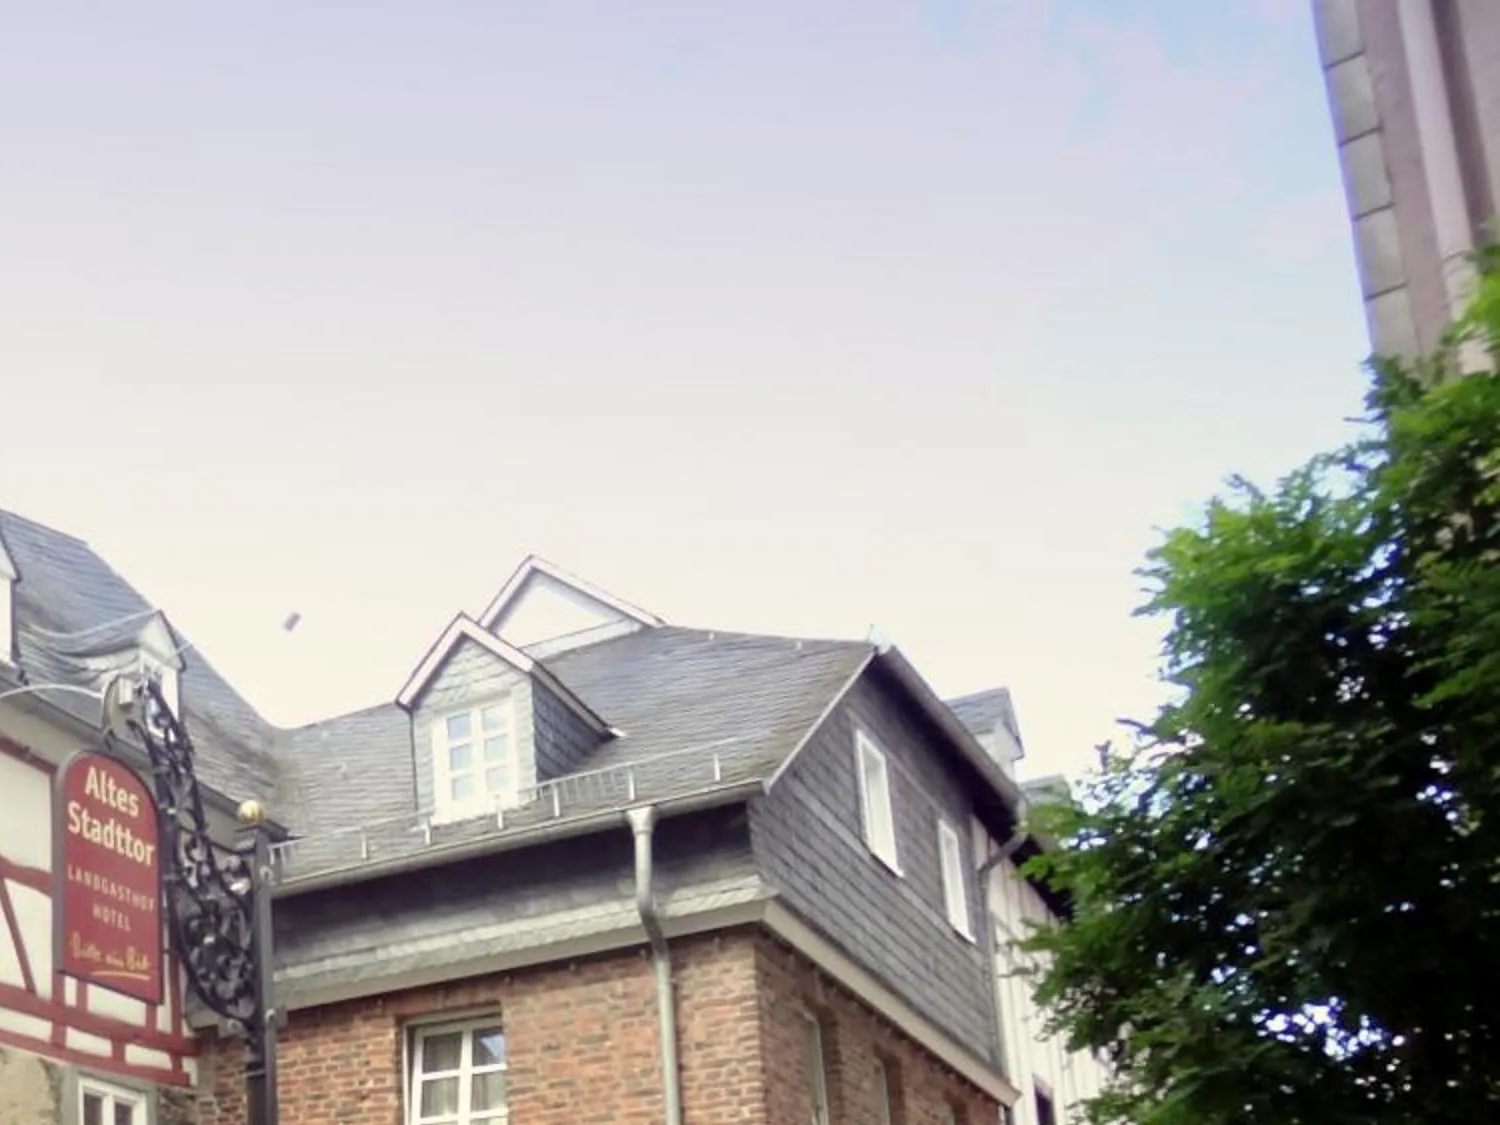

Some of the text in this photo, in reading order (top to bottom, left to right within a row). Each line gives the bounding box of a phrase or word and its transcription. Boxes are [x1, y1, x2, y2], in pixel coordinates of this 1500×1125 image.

[84, 766, 140, 818] Altes
[67, 801, 155, 867] Stadttor
[92, 903, 131, 932] HOTEL
